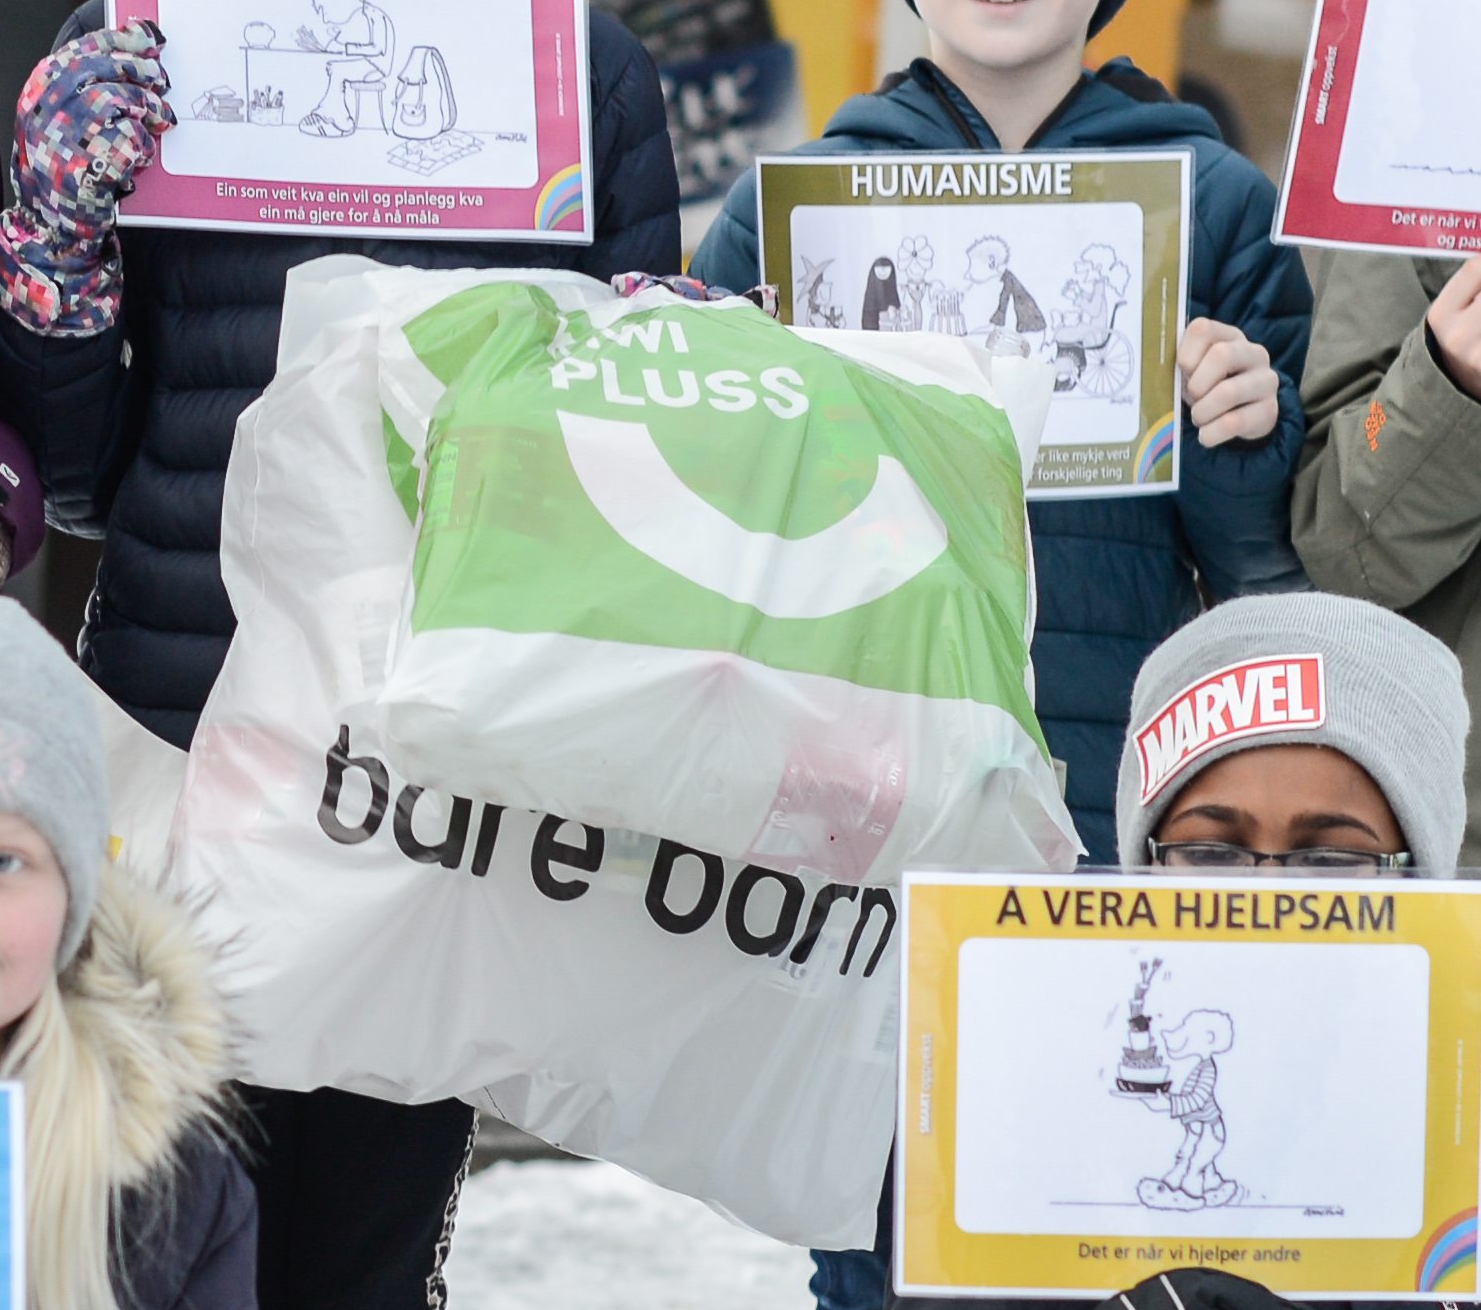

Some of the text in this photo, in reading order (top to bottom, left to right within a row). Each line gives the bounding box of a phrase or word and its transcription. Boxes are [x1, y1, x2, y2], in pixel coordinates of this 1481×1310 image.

[851, 163, 1072, 197] HUMANISME
[217, 183, 484, 209] Ein som veit kva ein vil og planlegg kva
[259, 205, 439, 225] ein må gjere for å nå måla
[1392, 210, 1416, 226] Det
[1420, 215, 1434, 227] er
[1438, 214, 1460, 229] når
[1464, 216, 1476, 229] vi
[1437, 235, 1455, 248] og
[546, 314, 689, 360] KWI
[549, 356, 810, 420] PLUSS
[1049, 450, 1069, 462] like
[1072, 449, 1104, 464] mykje
[1107, 447, 1130, 460] verd
[1038, 467, 1122, 483] forskjellige ting
[1140, 661, 1316, 796] MARVEL
[317, 724, 897, 978] bare barn
[1043, 890, 1157, 927] VERA
[1174, 892, 1394, 931] HJELPSAM
[1079, 1243, 1300, 1265] Det er når vi hjelper andre
